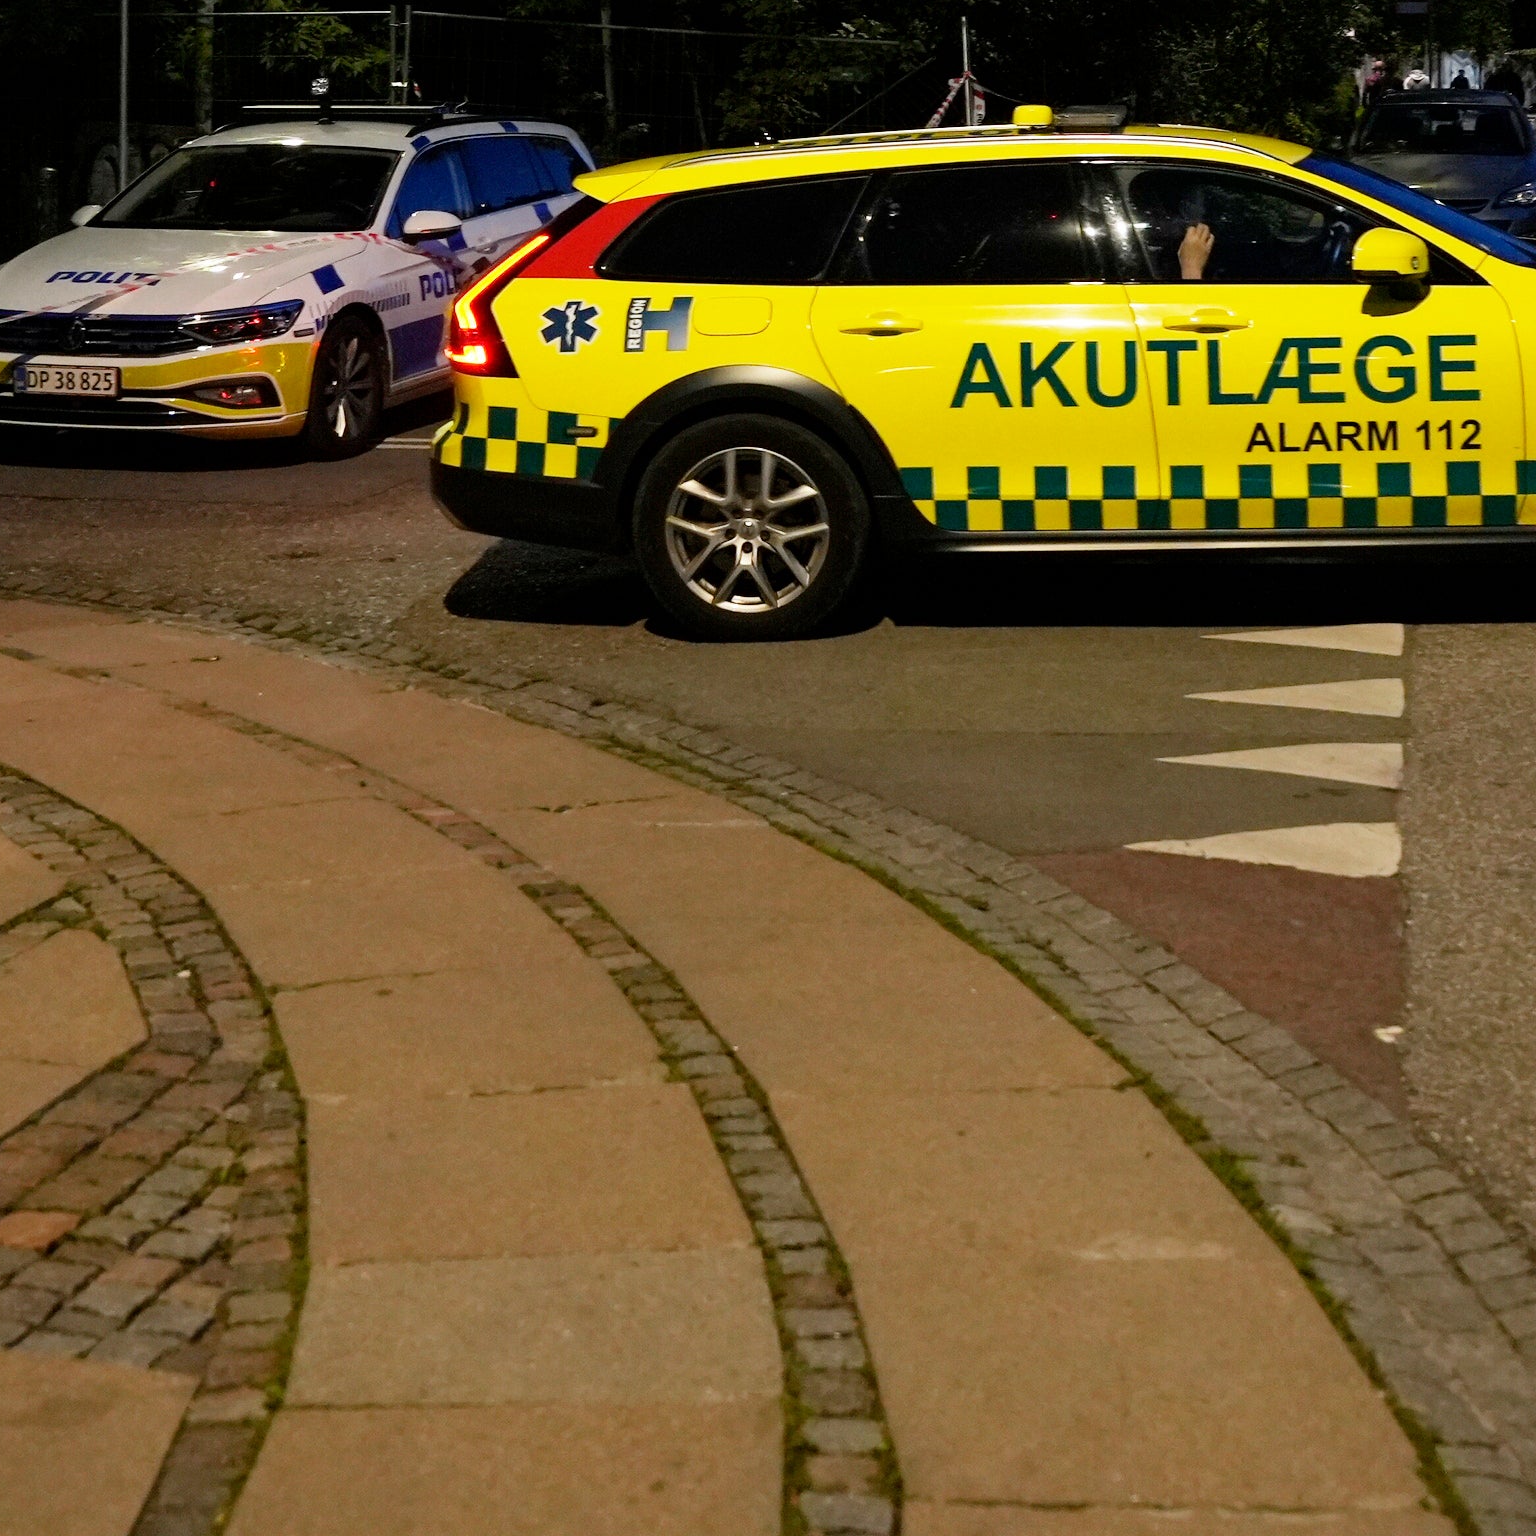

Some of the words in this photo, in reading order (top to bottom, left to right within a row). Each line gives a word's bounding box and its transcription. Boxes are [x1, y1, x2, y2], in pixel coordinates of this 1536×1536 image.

[627, 299, 648, 349] REGION
[27, 370, 50, 389] DP
[55, 371, 76, 390] 38
[80, 371, 113, 391] 825
[949, 333, 1482, 410] AKUTLÆGE
[1245, 420, 1399, 454] ALARM
[1414, 418, 1483, 452] 112
